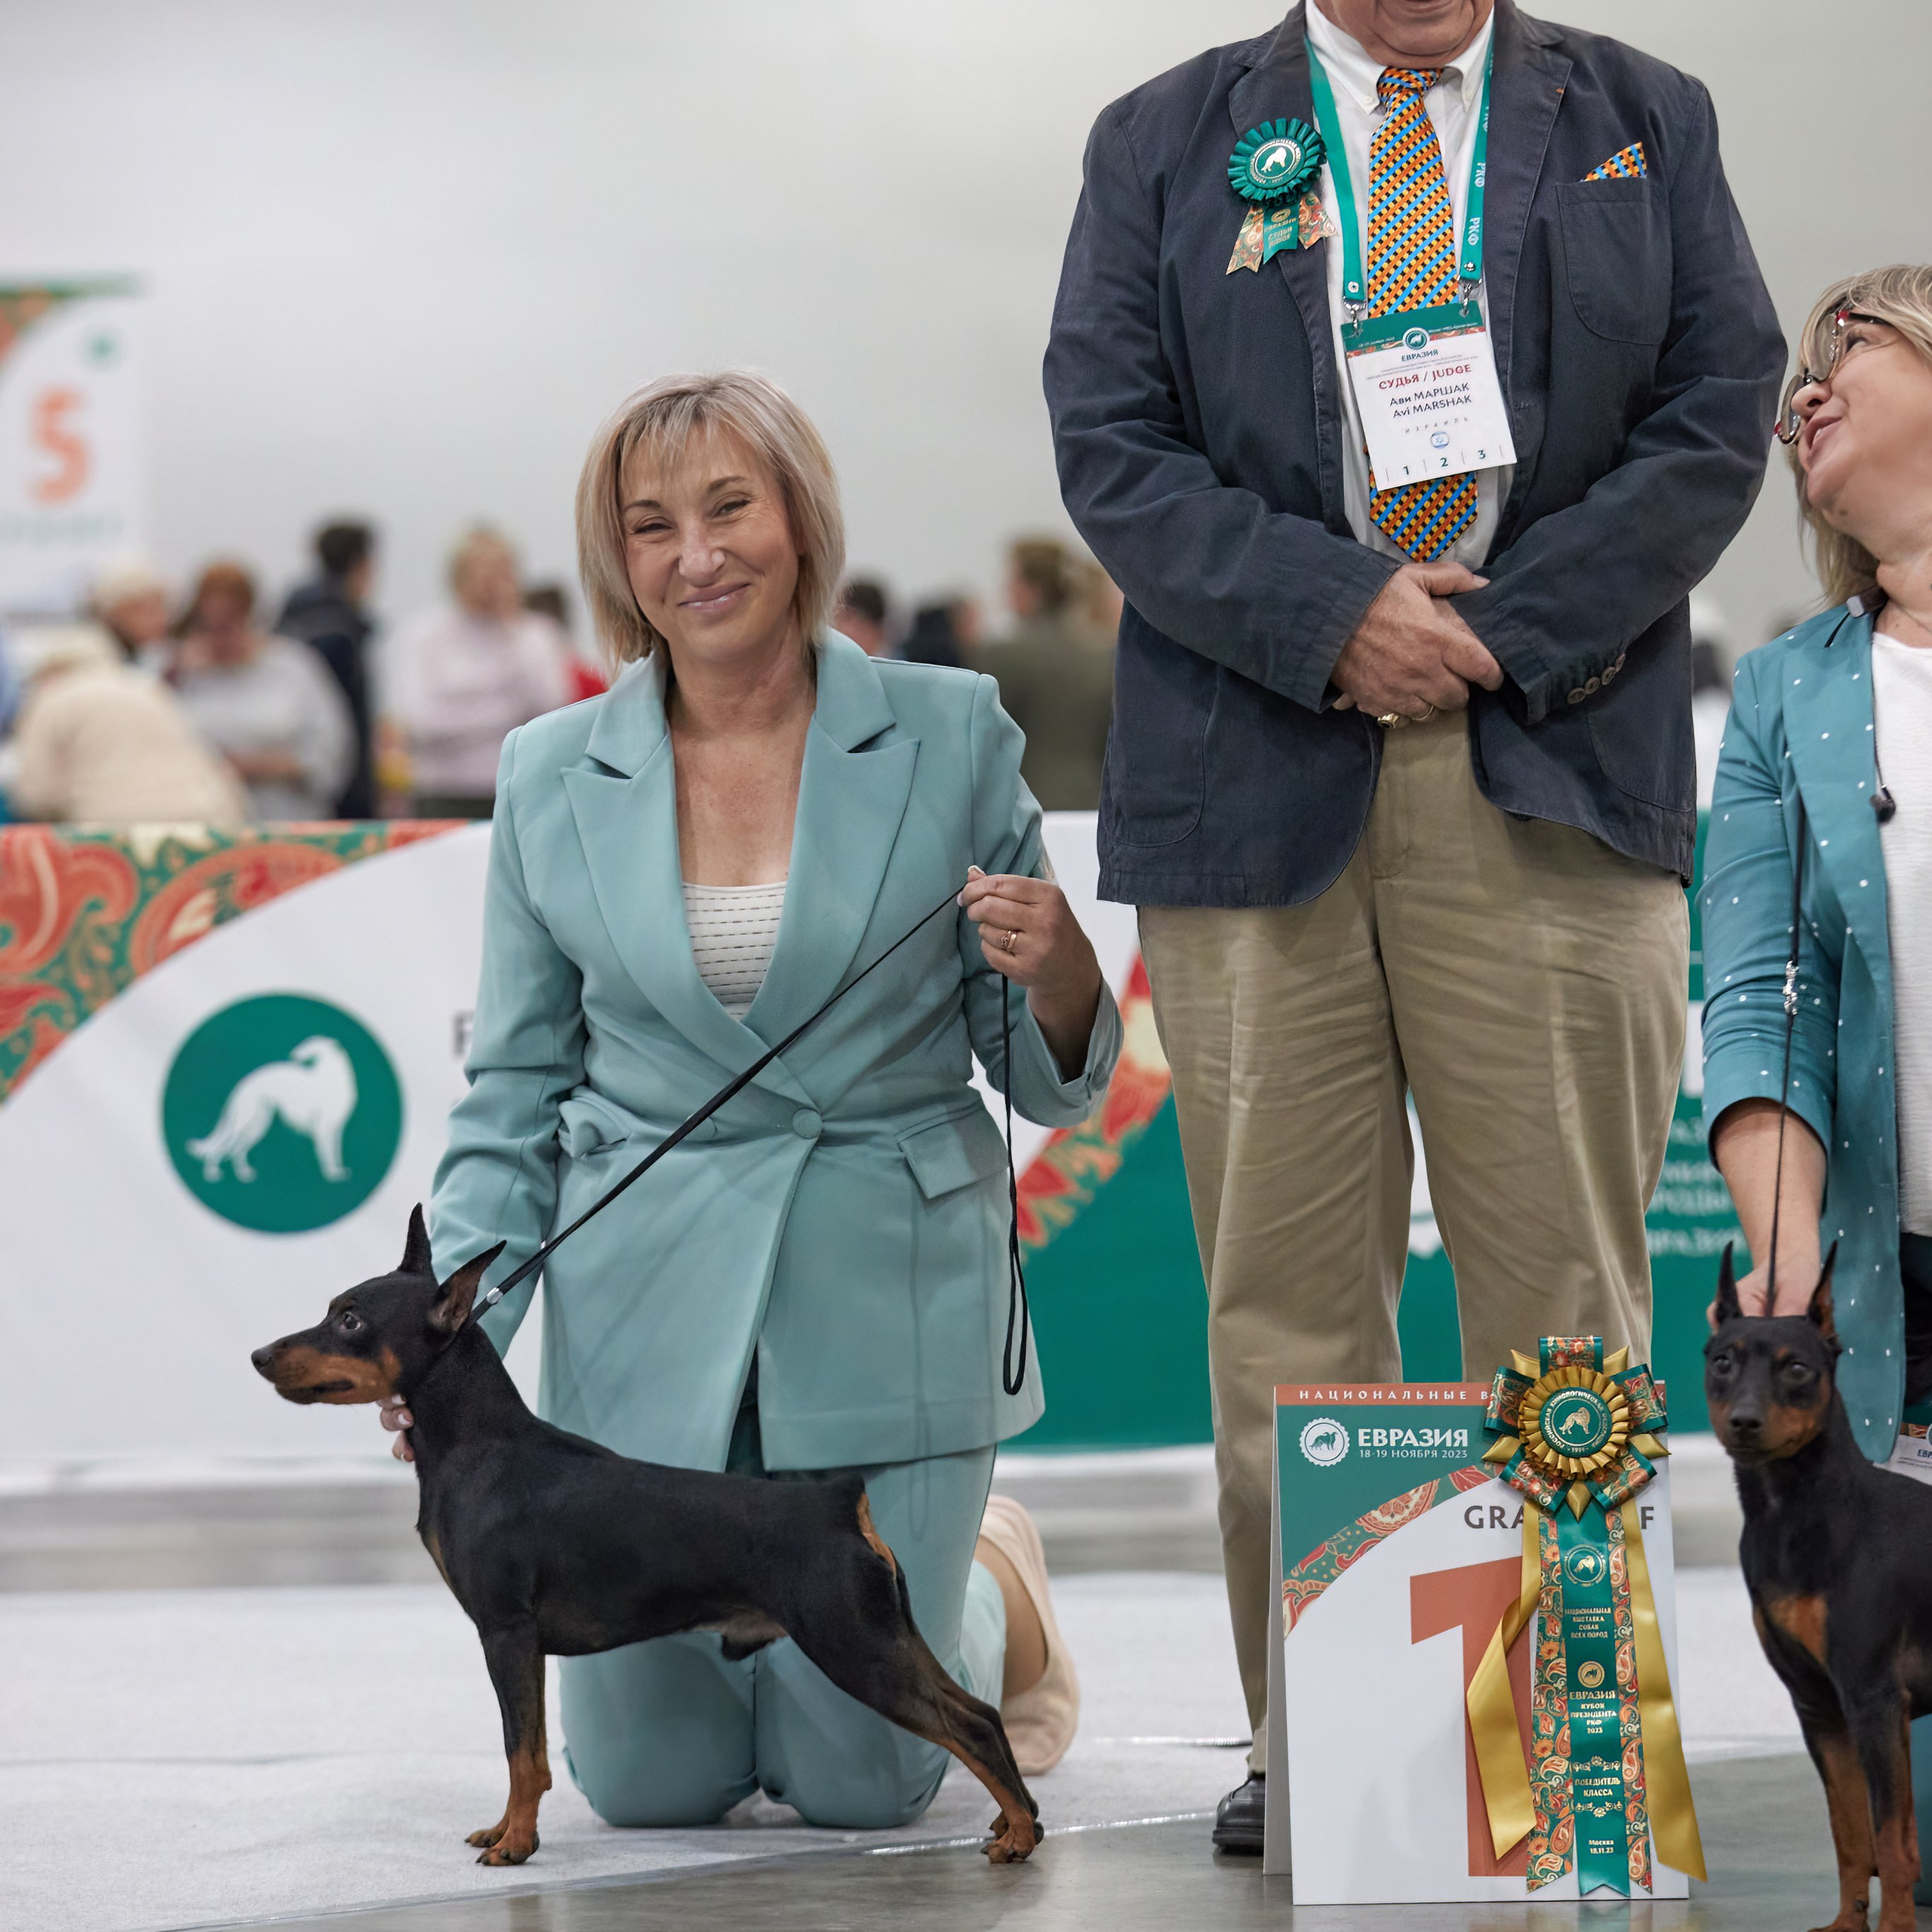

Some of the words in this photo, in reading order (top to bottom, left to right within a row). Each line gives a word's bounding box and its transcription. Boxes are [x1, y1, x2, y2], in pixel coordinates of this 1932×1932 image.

[1467, 217, 1481, 246] РКФ
[1401, 349, 1438, 362] ЕВРАЗИЯ
[1378, 374, 1420, 390] СУДЬЯ
[1423, 371, 1429, 383] /
[1432, 364, 1472, 382] JUDGE
[1389, 395, 1411, 407] Ави
[1414, 382, 1470, 401] МАРШАК
[1392, 407, 1411, 419] Avi
[1413, 394, 1472, 414] MARSHAK
[1403, 465, 1410, 475] 1
[1440, 457, 1449, 467] 2
[1478, 450, 1486, 460] 3
[1300, 1390, 1466, 1401] НАЦИОНАЛЬНЫЕ
[1358, 1429, 1469, 1447] ЕВРАЗИЯ
[1359, 1450, 1387, 1458] 18-19
[1392, 1450, 1438, 1458] НОЯБРЯ
[1441, 1450, 1467, 1458] 2023
[1463, 1505, 1524, 1529] GRA
[1641, 1506, 1654, 1530] F
[1570, 1690, 1615, 1700] ЕВРАЗИЯ
[1410, 1555, 1531, 1877] 1
[1571, 1710, 1617, 1718] ПРЕЗИДЕНТА
[1574, 1777, 1621, 1786] ПОБЕДИТЕЛЬ
[1583, 1789, 1614, 1797] КЛАССА
